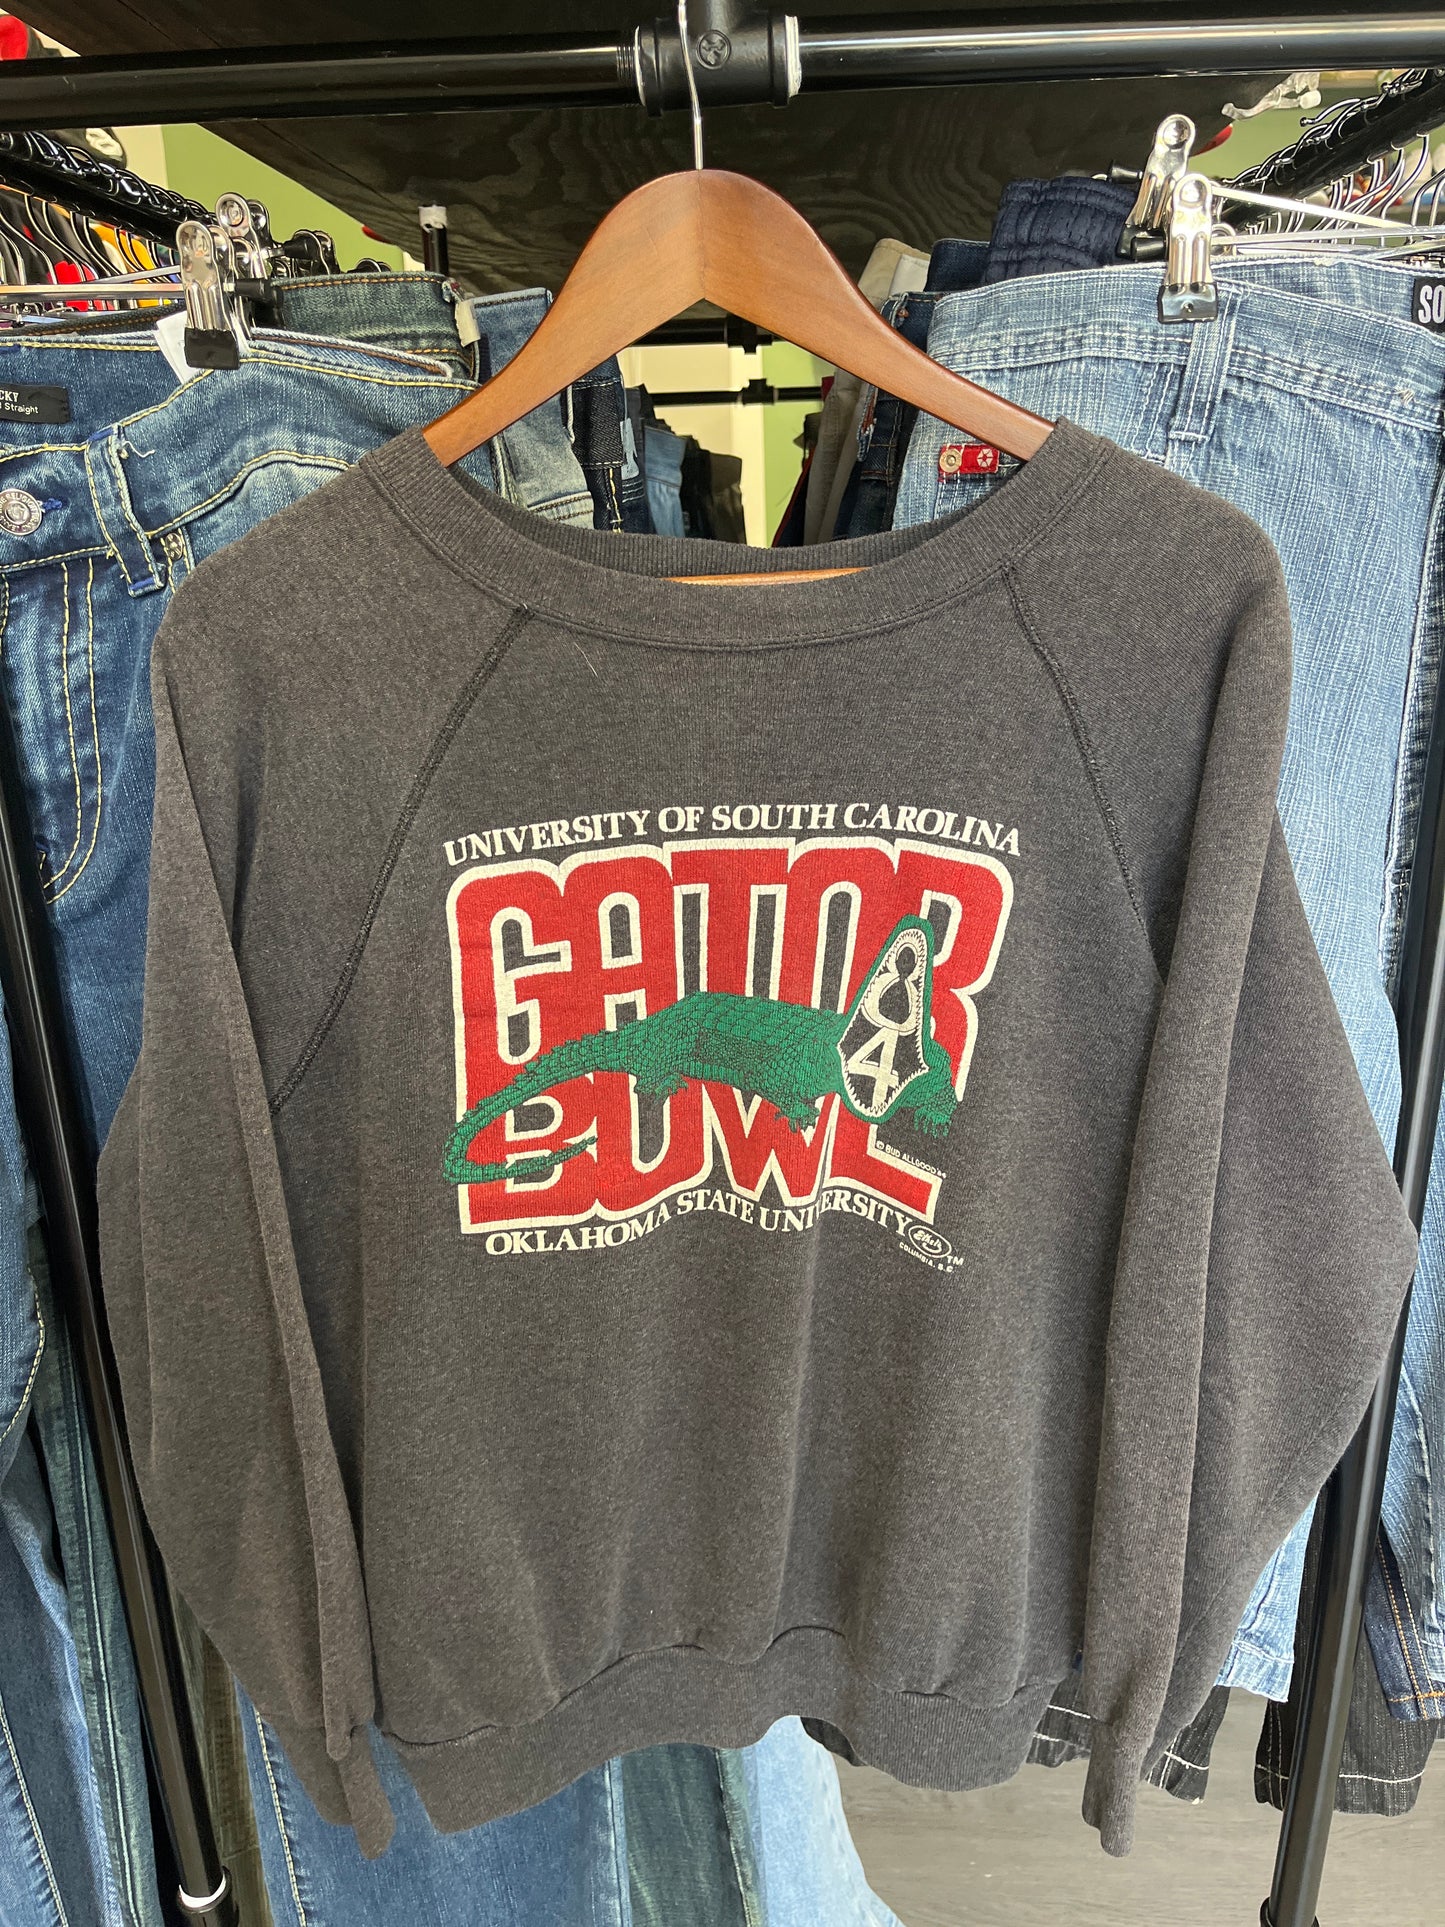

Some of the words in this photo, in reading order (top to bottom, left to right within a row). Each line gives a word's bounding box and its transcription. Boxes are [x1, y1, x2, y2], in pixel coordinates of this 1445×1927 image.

[4, 402, 39, 415] Straight
[443, 809, 650, 866] UNIVERSITY
[657, 805, 704, 833] OF
[711, 803, 837, 831] SOUTH
[843, 803, 1020, 857] CAROLINA
[446, 837, 1015, 1102] GATOR
[458, 1072, 944, 1235] BOWL
[885, 1144, 901, 1158] BUD
[485, 1203, 672, 1255] OKLAHOMA
[676, 1189, 754, 1225] STATE
[946, 1255, 965, 1267] TM
